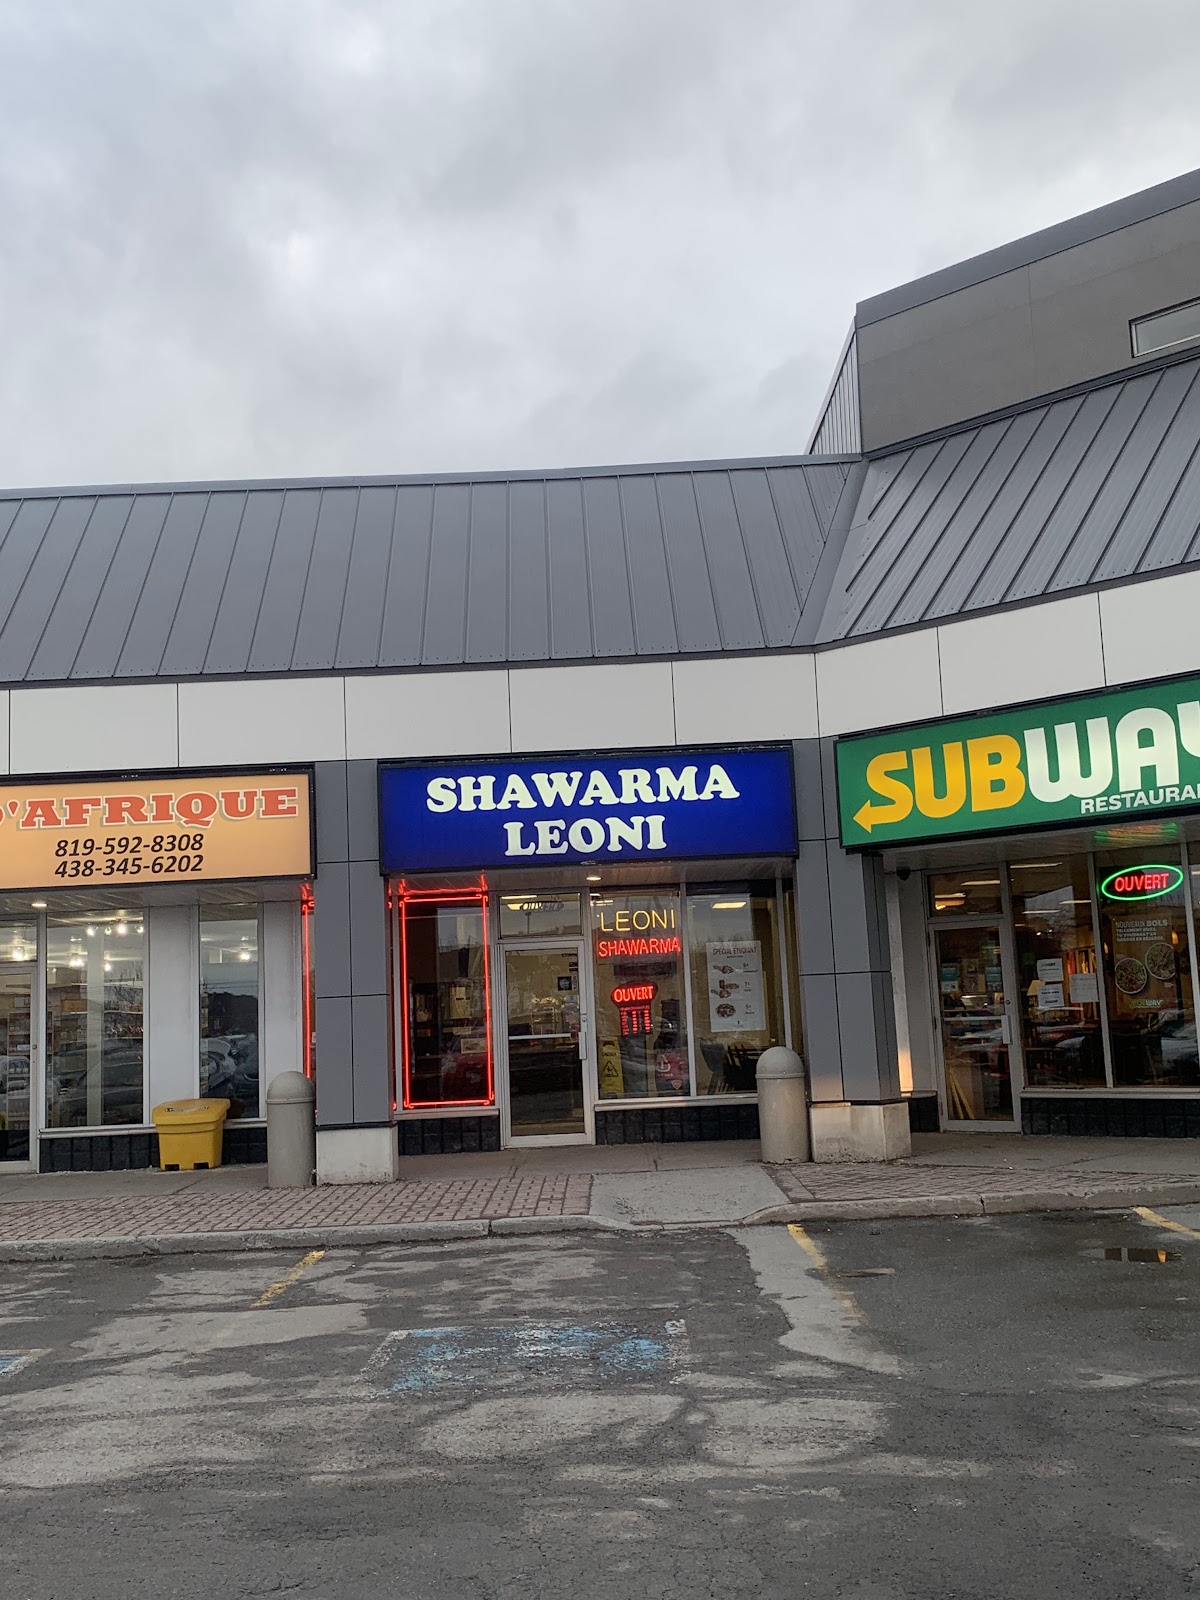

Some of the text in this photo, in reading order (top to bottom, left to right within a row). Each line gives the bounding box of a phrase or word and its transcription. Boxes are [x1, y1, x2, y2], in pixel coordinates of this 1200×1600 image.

[426, 764, 741, 813] SHAWARMA
[1080, 783, 1200, 814] RESTAURA
[0, 788, 298, 829] 'AFRIQUE
[55, 833, 204, 857] 819-592-8308
[503, 815, 667, 856] LEONI
[55, 854, 204, 878] 438-345-6202
[1114, 873, 1169, 892] OUVERT
[600, 909, 675, 932] LEONI
[599, 937, 681, 957] SHAWARMA
[613, 985, 654, 1002] OUVERT
